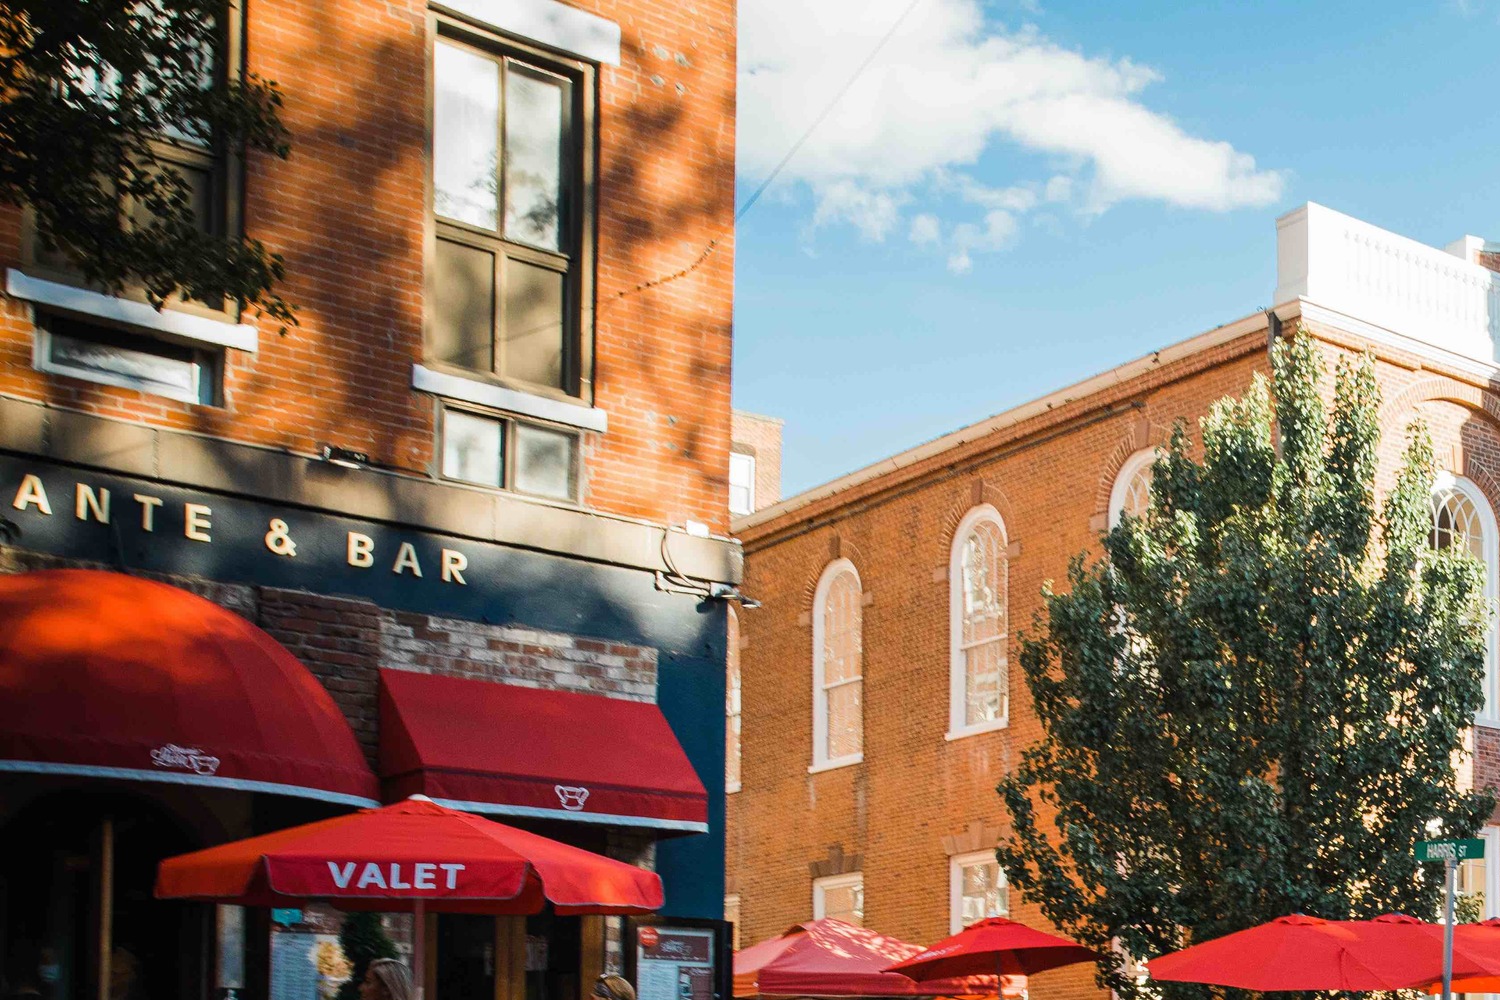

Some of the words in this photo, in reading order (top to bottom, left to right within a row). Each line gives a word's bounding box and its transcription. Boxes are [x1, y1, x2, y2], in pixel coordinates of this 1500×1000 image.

[12, 473, 212, 543] ANTE
[264, 517, 297, 557] &
[346, 530, 468, 585] BAR
[1426, 842, 1457, 859] HARRIS
[1458, 845, 1467, 857] ST
[326, 861, 466, 890] VALET
